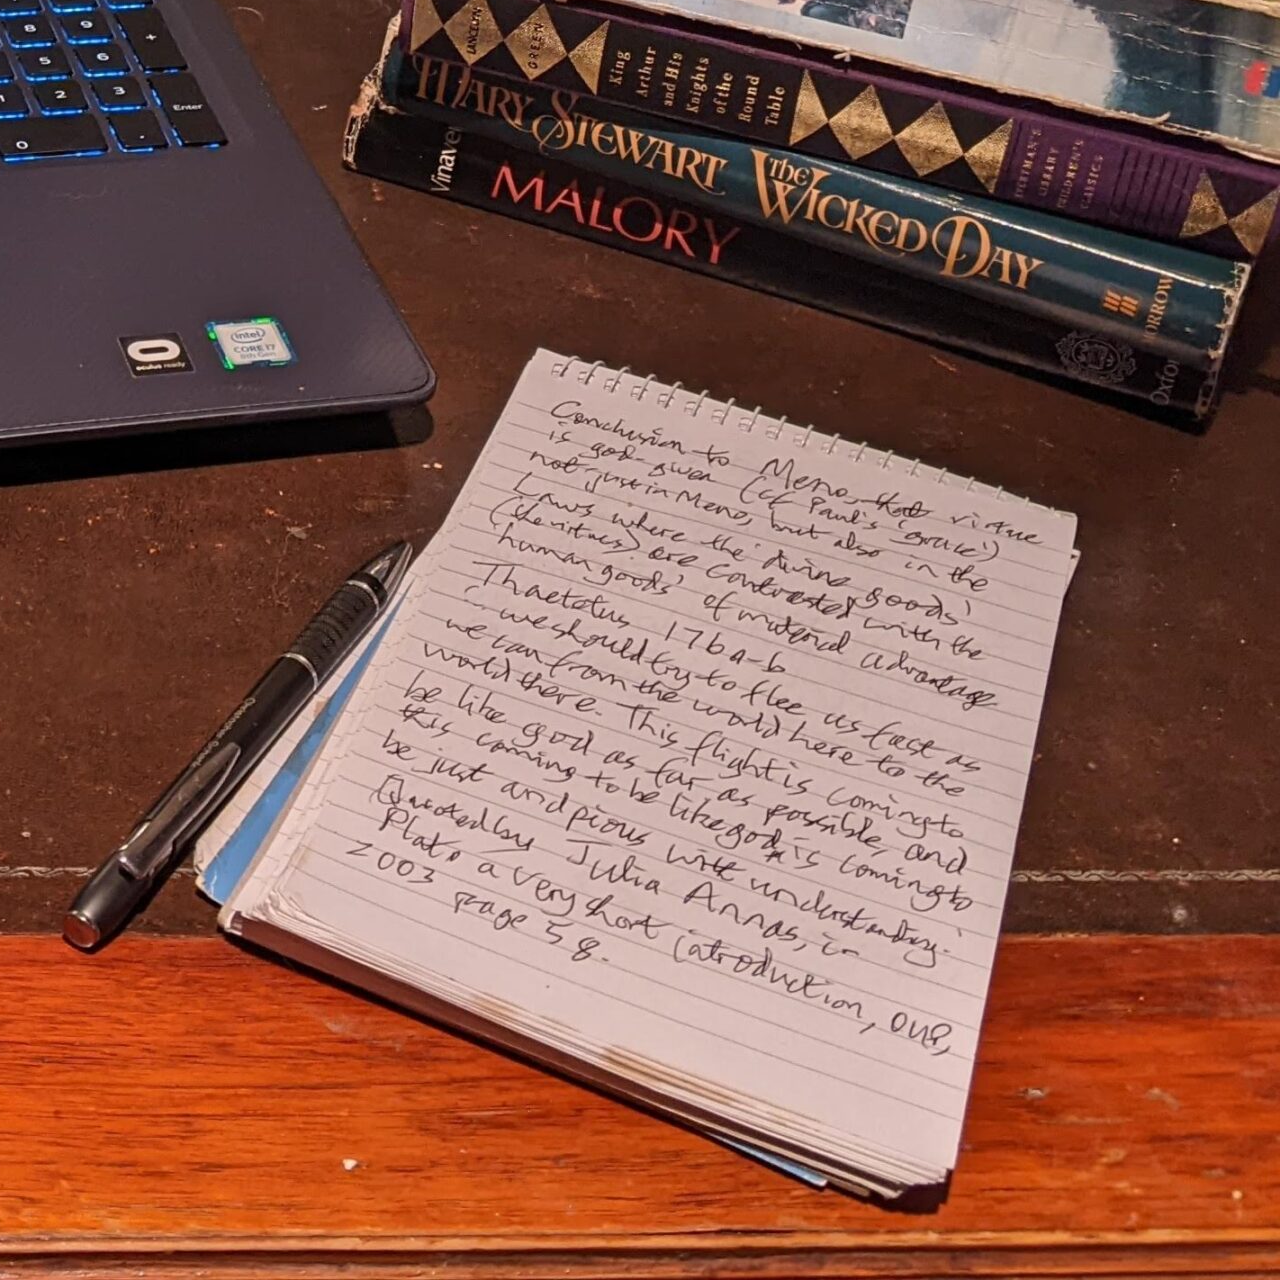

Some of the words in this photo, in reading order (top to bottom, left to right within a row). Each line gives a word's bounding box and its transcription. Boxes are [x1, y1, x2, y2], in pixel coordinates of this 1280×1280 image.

[527, 22, 545, 70] GREEN
[609, 50, 632, 86] King
[635, 45, 657, 98] Arthur
[685, 56, 710, 114] Knights
[172, 102, 204, 112] Enter
[737, 74, 761, 124] Round
[764, 85, 786, 126] Table
[490, 161, 742, 266] MALORY
[750, 148, 928, 257] WICKED
[931, 214, 1046, 290] DAY
[1143, 273, 1174, 338] ORROW
[233, 345, 263, 354] CORE
[691, 444, 730, 467] to
[345, 840, 436, 885] 2003
